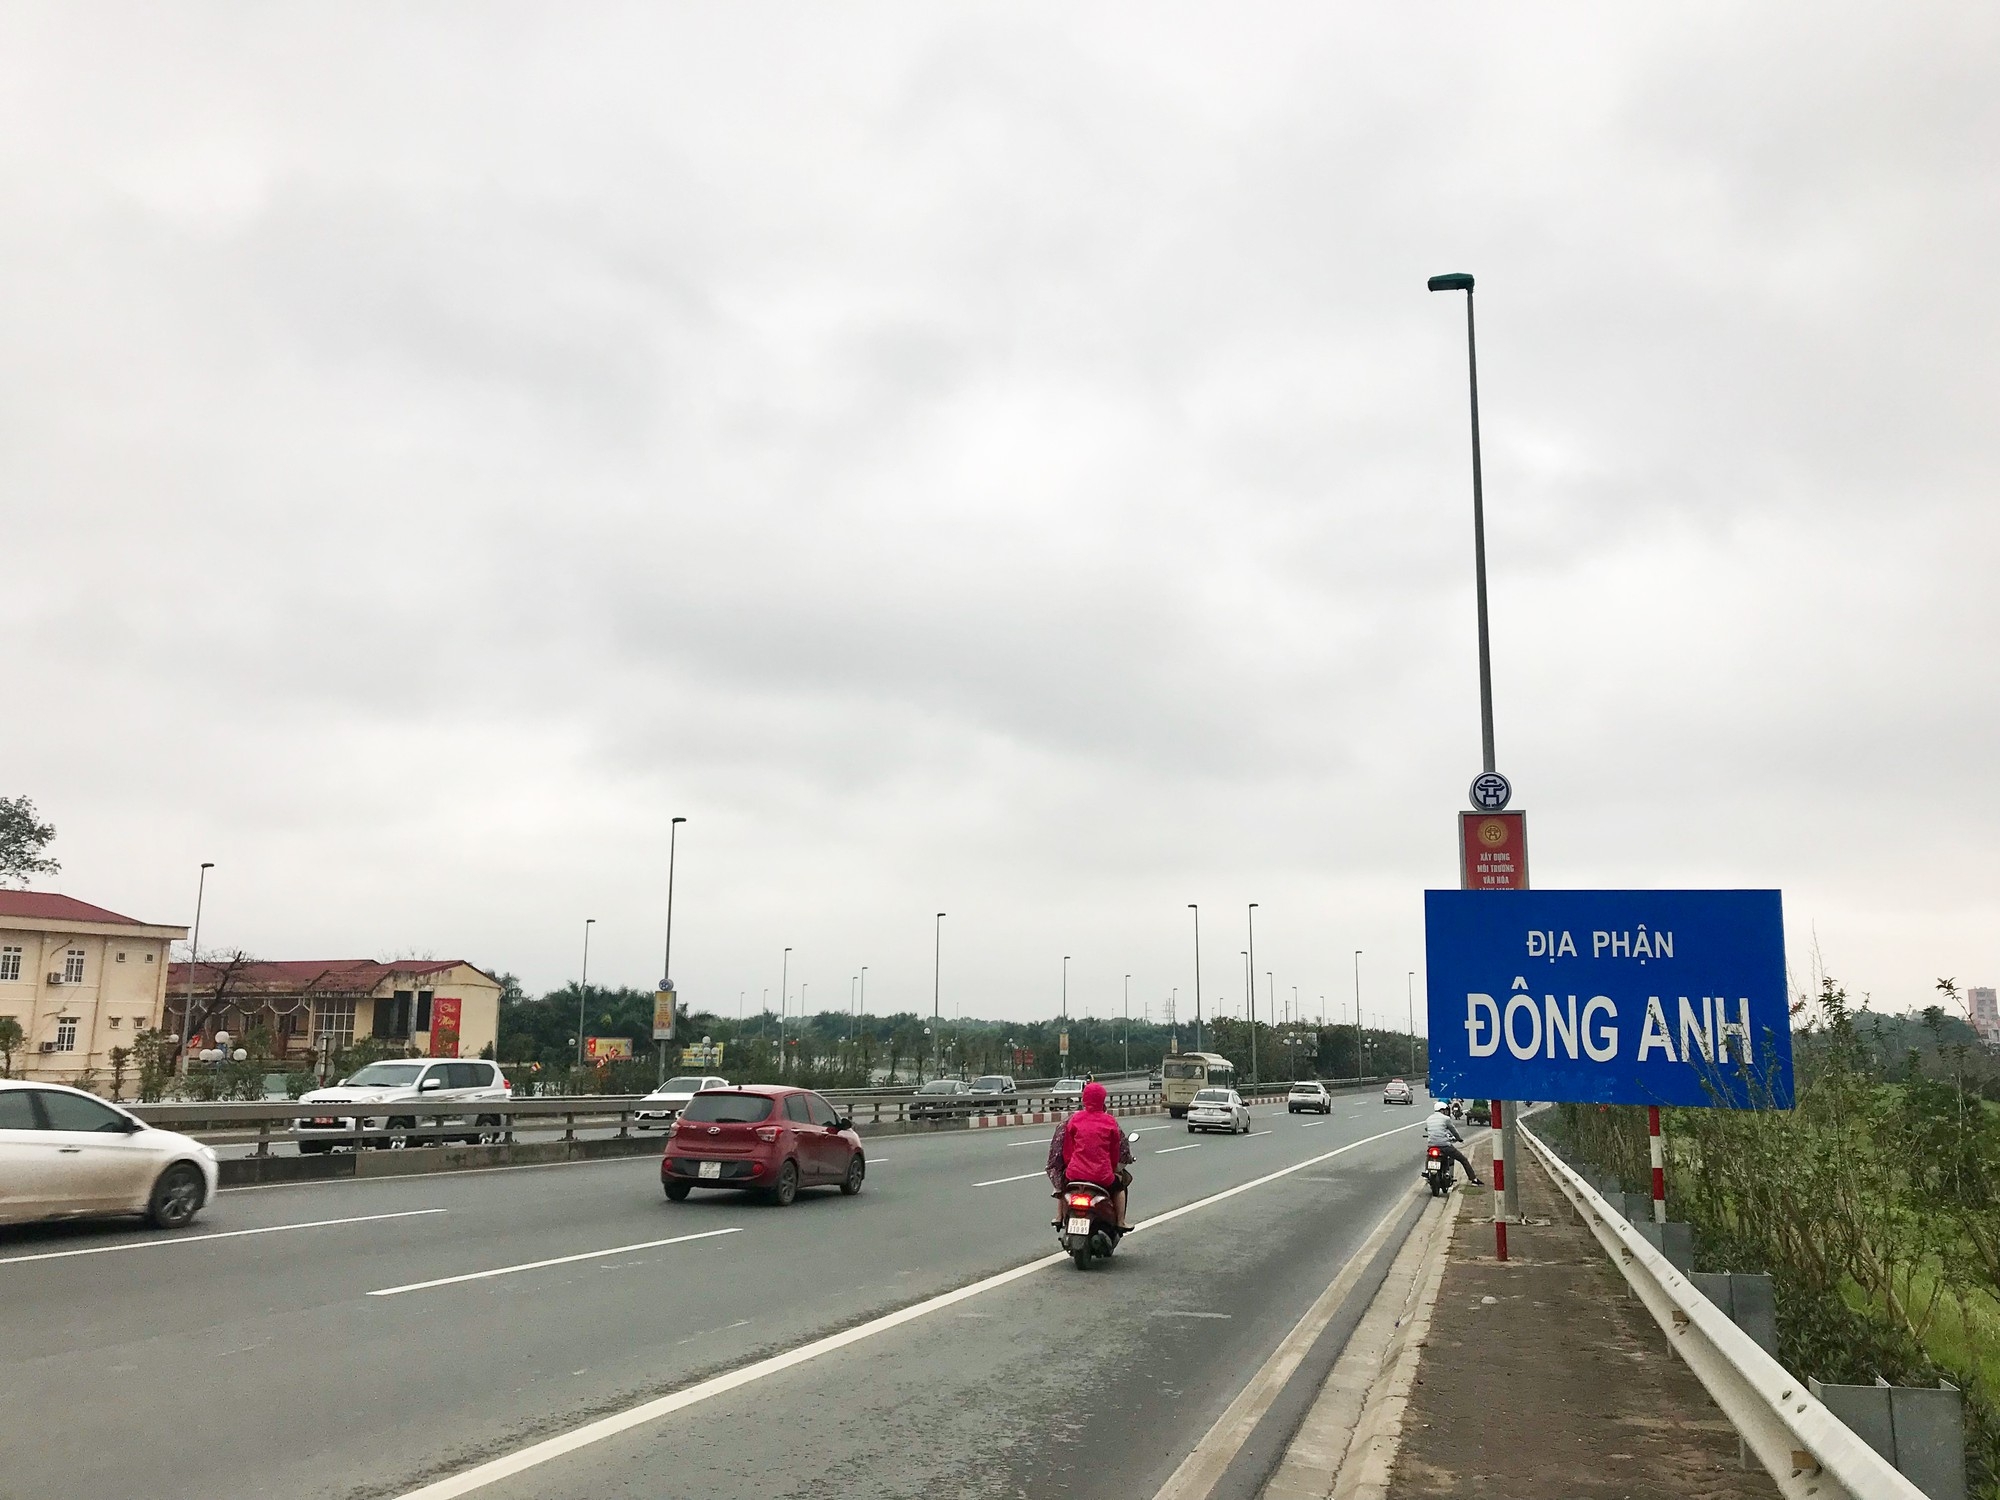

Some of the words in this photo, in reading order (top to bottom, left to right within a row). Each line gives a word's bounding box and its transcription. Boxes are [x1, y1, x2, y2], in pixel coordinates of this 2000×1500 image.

[1526, 930, 1578, 964] ĐỊA
[1592, 923, 1674, 965] PHẬN
[1464, 976, 1618, 1062] ĐÔNG
[1637, 996, 1754, 1065] ANH
